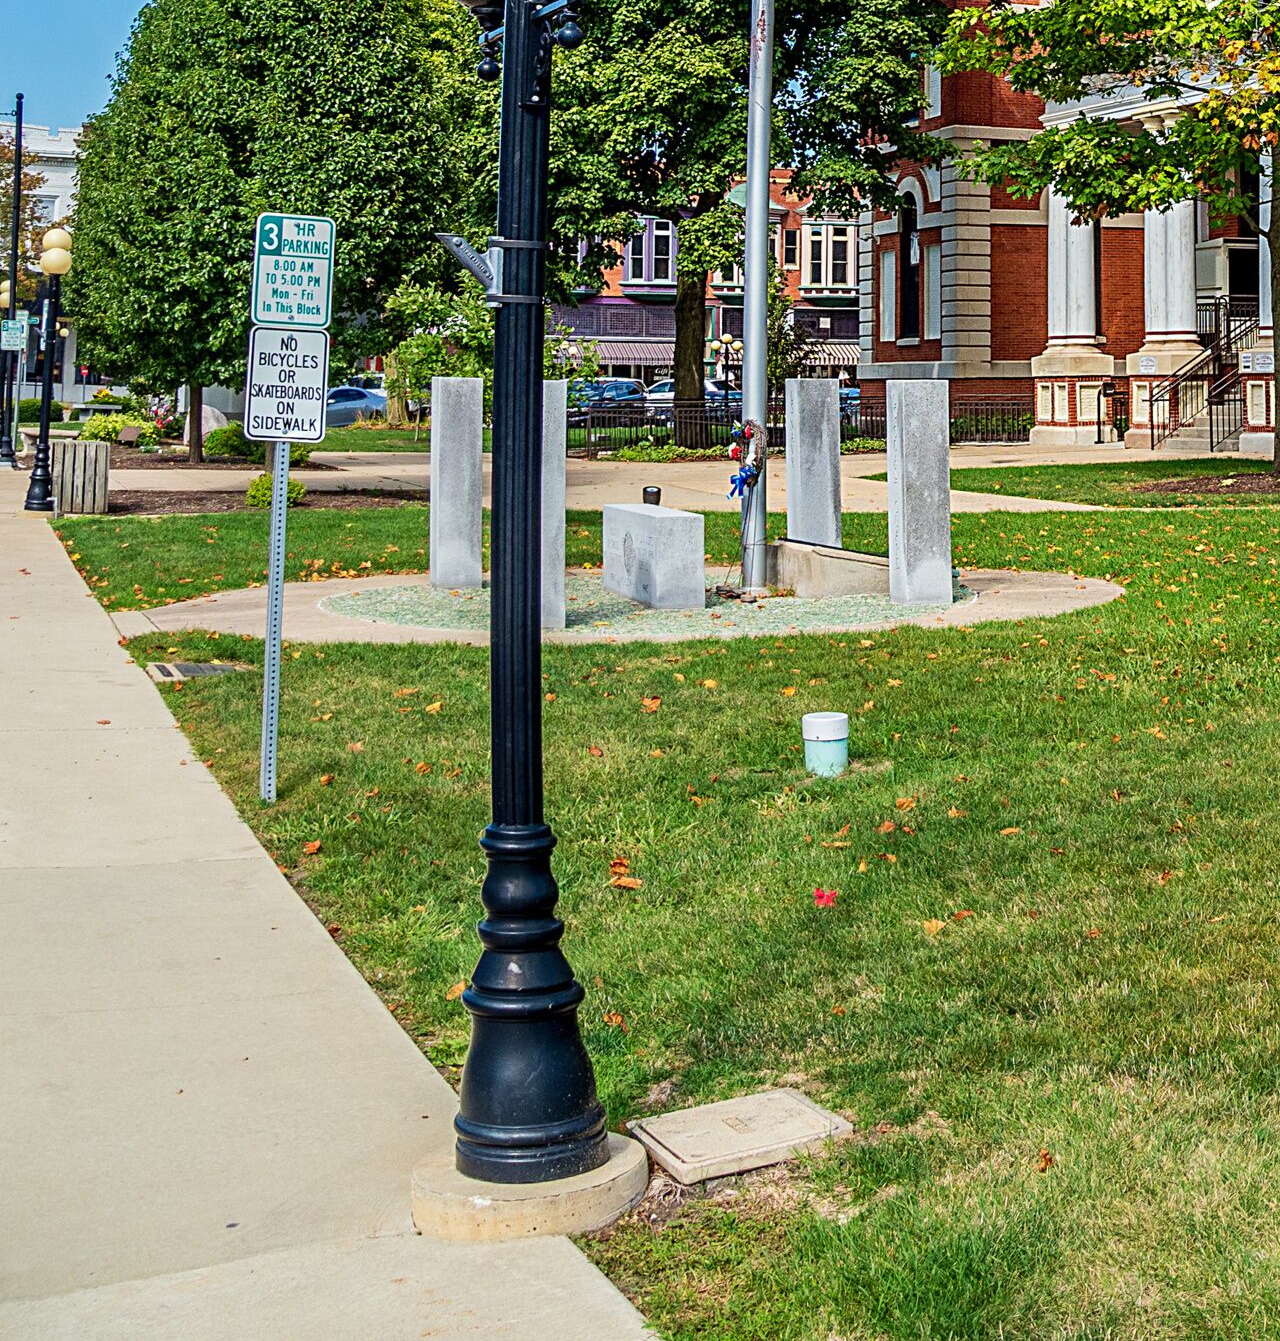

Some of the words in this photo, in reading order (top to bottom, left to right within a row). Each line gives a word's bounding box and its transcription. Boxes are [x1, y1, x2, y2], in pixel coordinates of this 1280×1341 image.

[263, 223, 279, 250] 3
[297, 223, 315, 237] HR
[283, 239, 329, 255] PARKING
[274, 261, 296, 272] 8:00
[300, 261, 314, 272] AM
[266, 274, 278, 284] TO
[281, 274, 304, 286] 5:00
[308, 276, 320, 287] PM
[272, 287, 289, 299] Mon
[302, 290, 314, 300] Fri
[263, 301, 271, 312] In
[275, 302, 293, 314] This
[297, 304, 320, 315] Block
[281, 338, 297, 352] NO
[259, 352, 318, 368] BICYCLES
[279, 370, 295, 383] OR
[252, 384, 321, 401] SKATEBOARDS
[277, 401, 294, 415] ON
[253, 416, 316, 432] SIDEWALK
